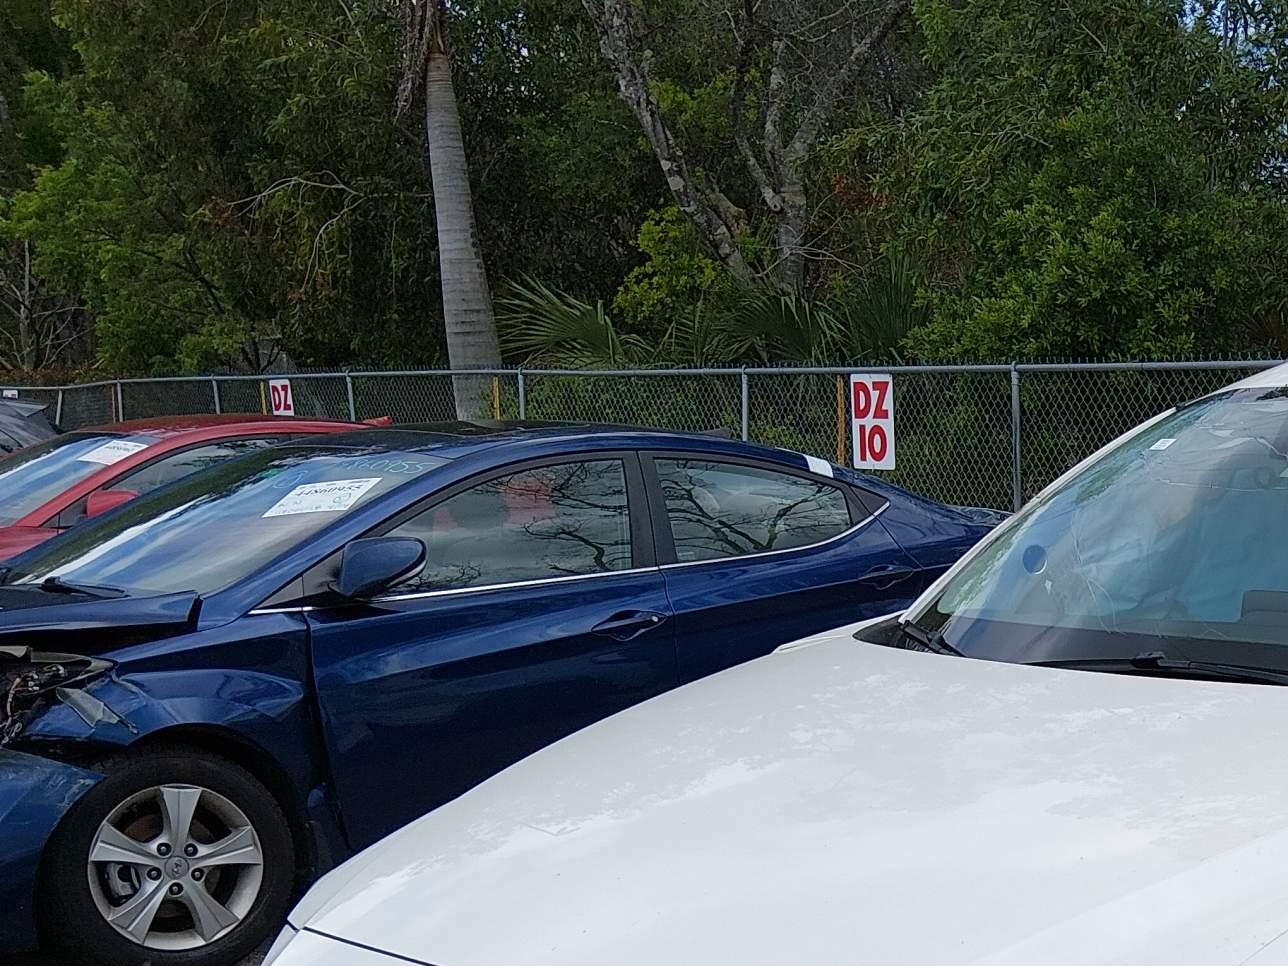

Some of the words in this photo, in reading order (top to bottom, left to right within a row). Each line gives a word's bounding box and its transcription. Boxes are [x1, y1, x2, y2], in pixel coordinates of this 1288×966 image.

[271, 384, 292, 411] DZ
[853, 380, 889, 420] DZ
[858, 424, 888, 462] 10
